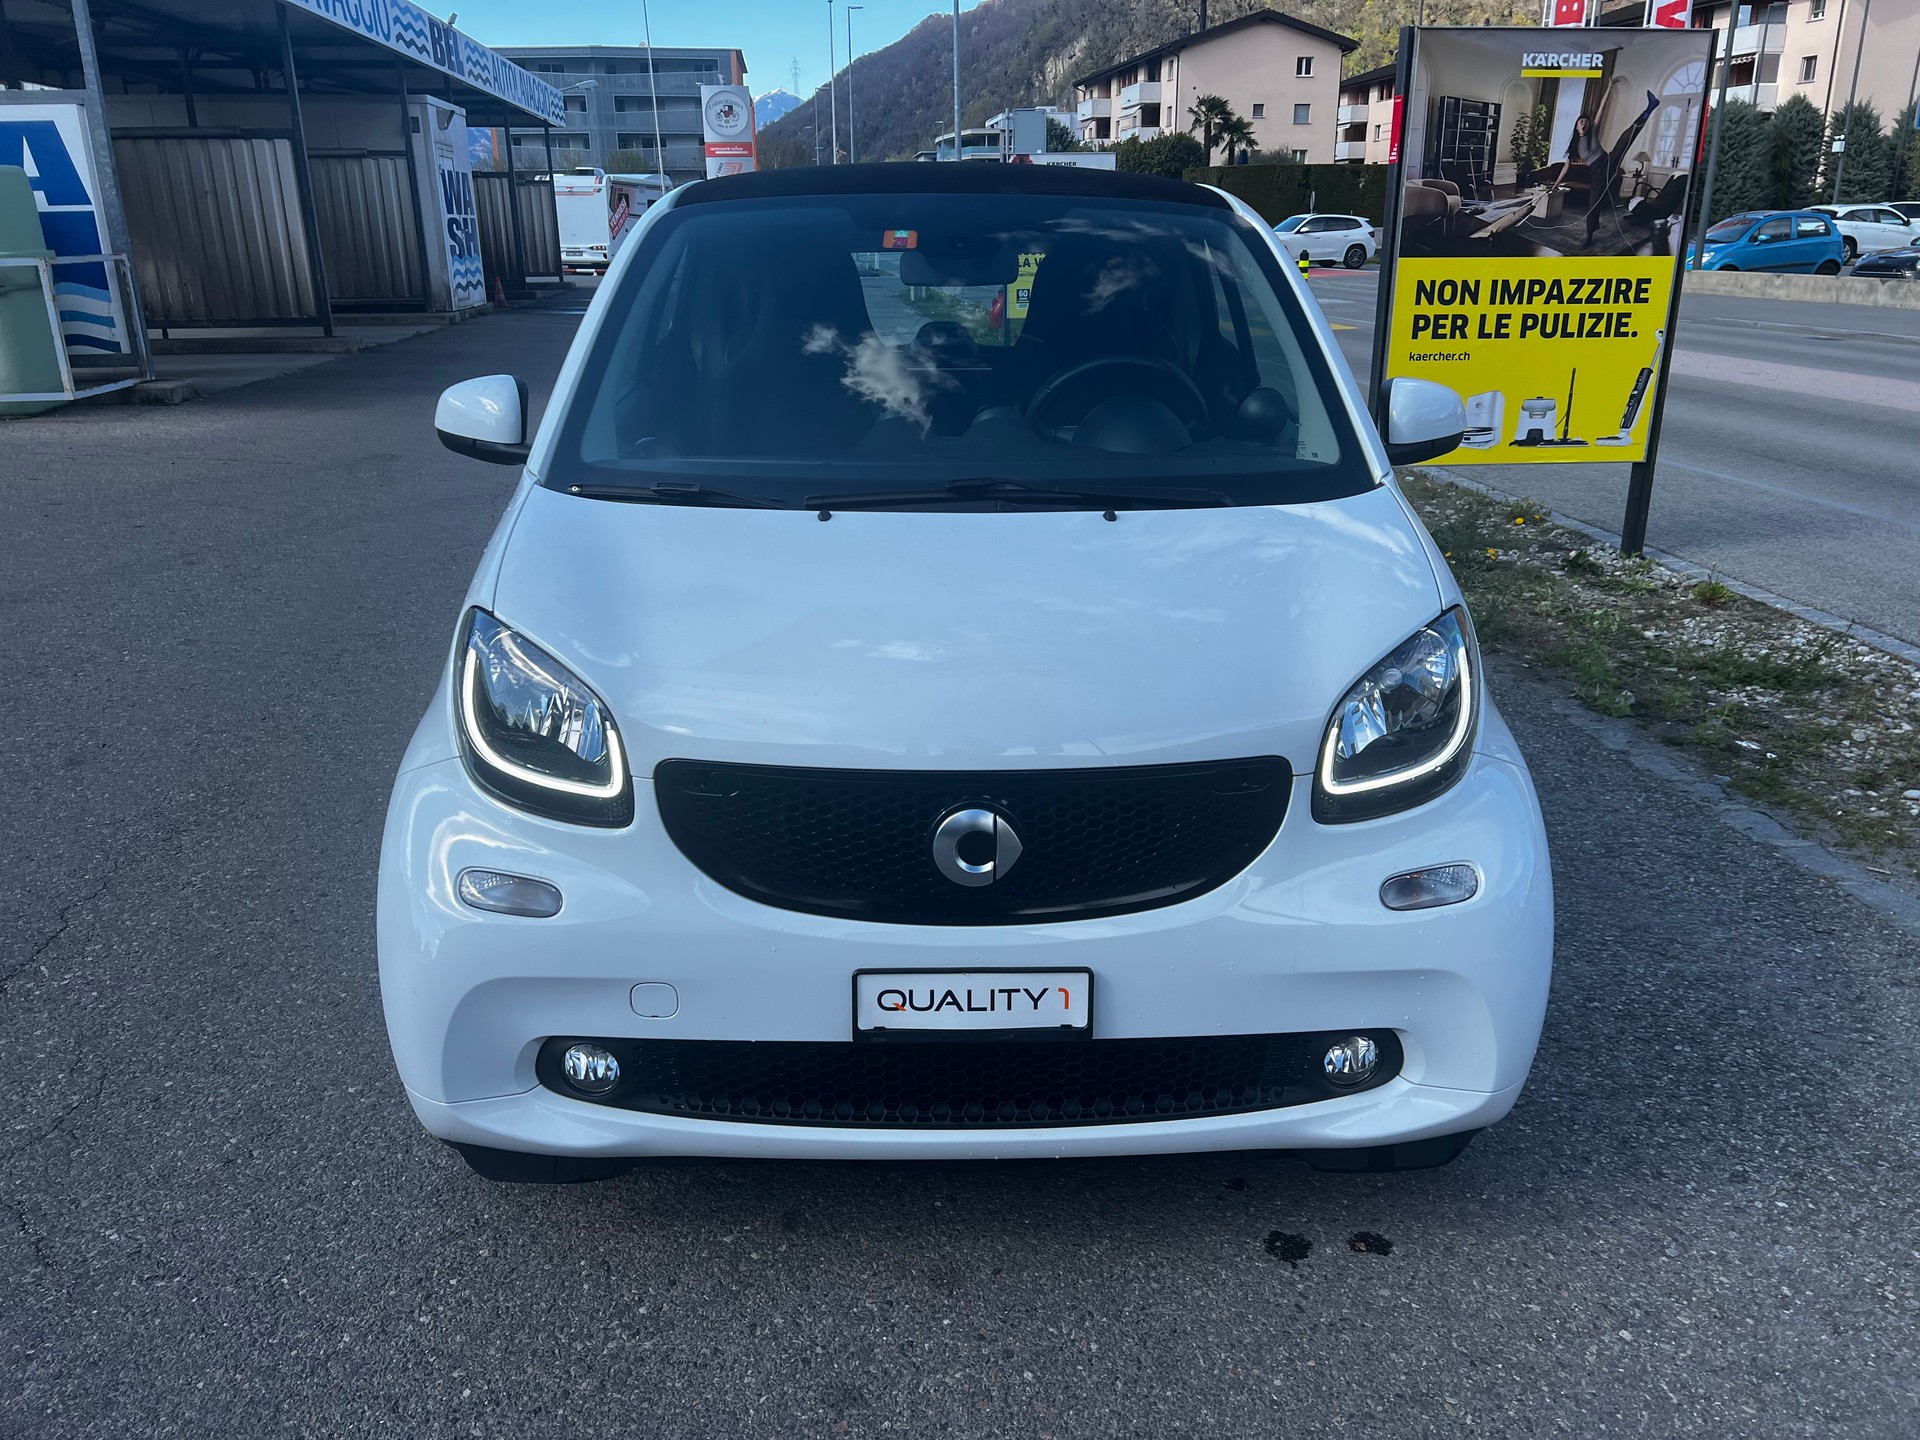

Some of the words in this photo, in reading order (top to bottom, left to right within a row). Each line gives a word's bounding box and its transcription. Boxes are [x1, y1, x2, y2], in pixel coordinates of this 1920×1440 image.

[428, 16, 465, 76] BEL
[1522, 52, 1604, 68] KÄRCHER
[491, 54, 551, 118] AUTOLAVAGGIO
[1415, 279, 1480, 306] NON
[1489, 278, 1652, 305] IMPAZZIRE
[1411, 314, 1469, 339] PER
[1477, 313, 1512, 339] LE
[1519, 312, 1639, 339] PULIZIE.
[1408, 351, 1471, 362] kaercher.ch
[876, 987, 1049, 1012] QUALITY
[1057, 987, 1070, 1010] 1
